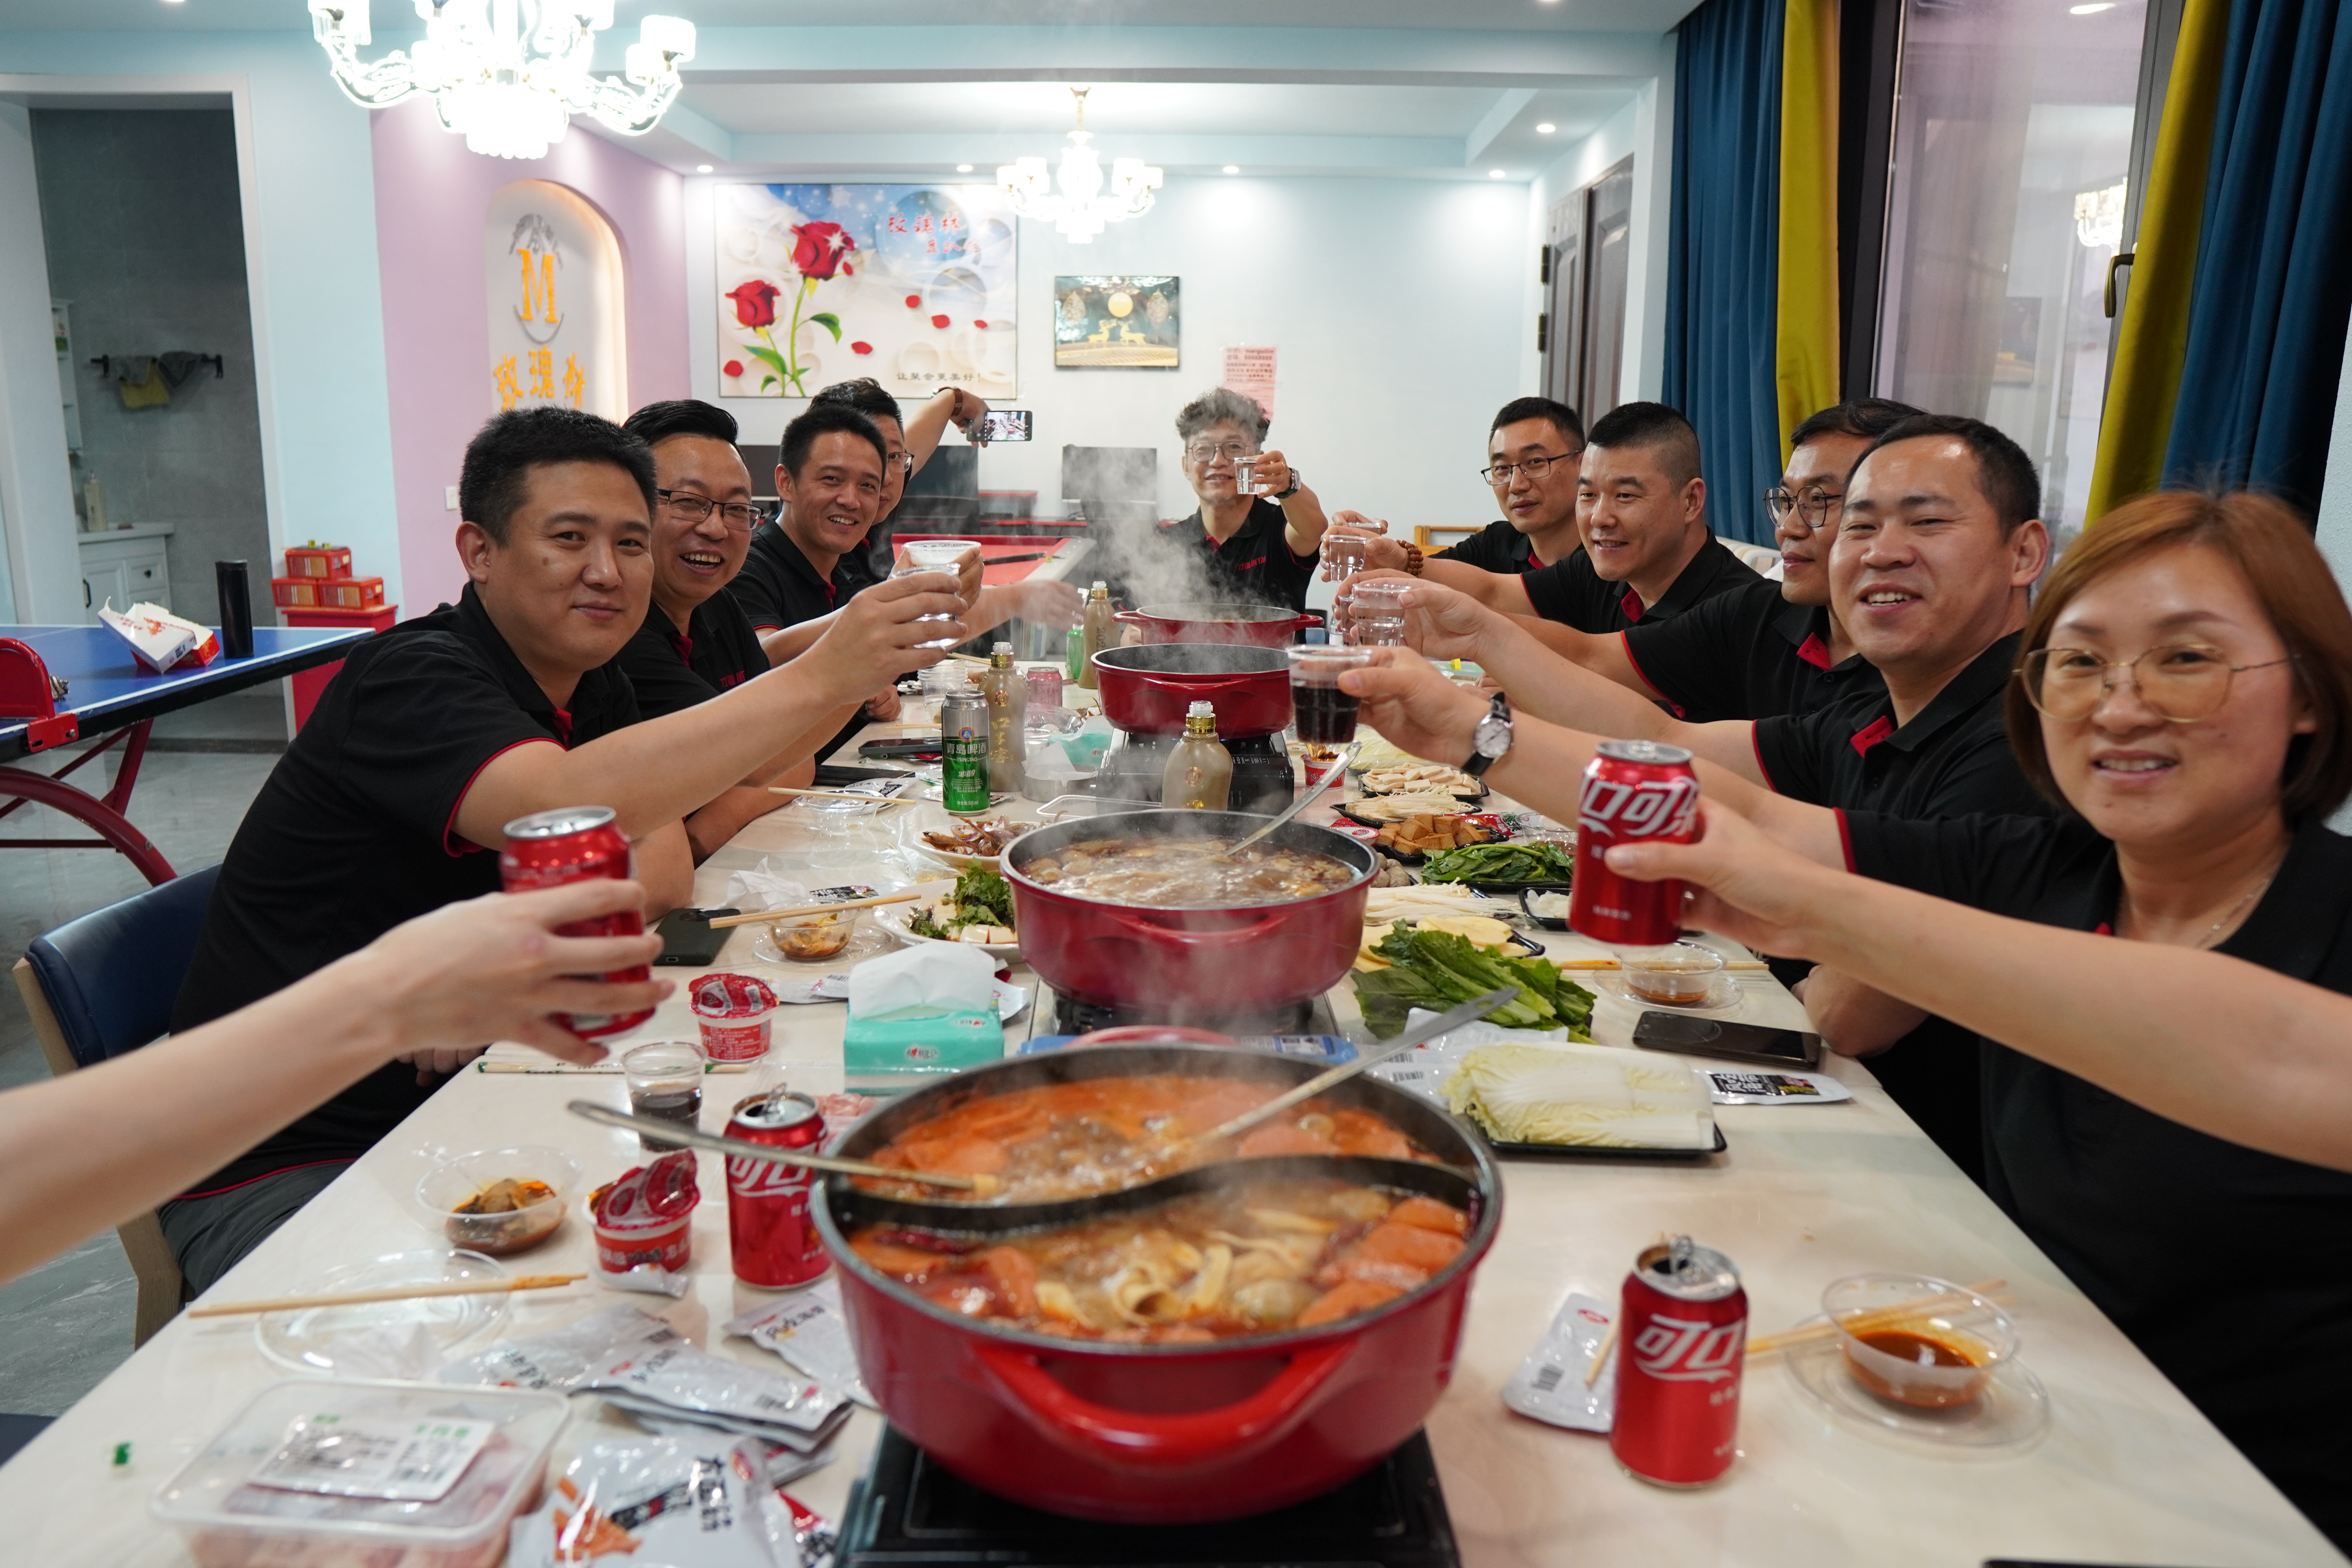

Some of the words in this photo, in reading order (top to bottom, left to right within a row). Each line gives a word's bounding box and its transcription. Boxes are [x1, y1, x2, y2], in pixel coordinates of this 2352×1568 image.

[887, 212, 962, 234] 玫瑰林
[517, 248, 559, 323] M
[493, 345, 586, 410] 玫瑰林
